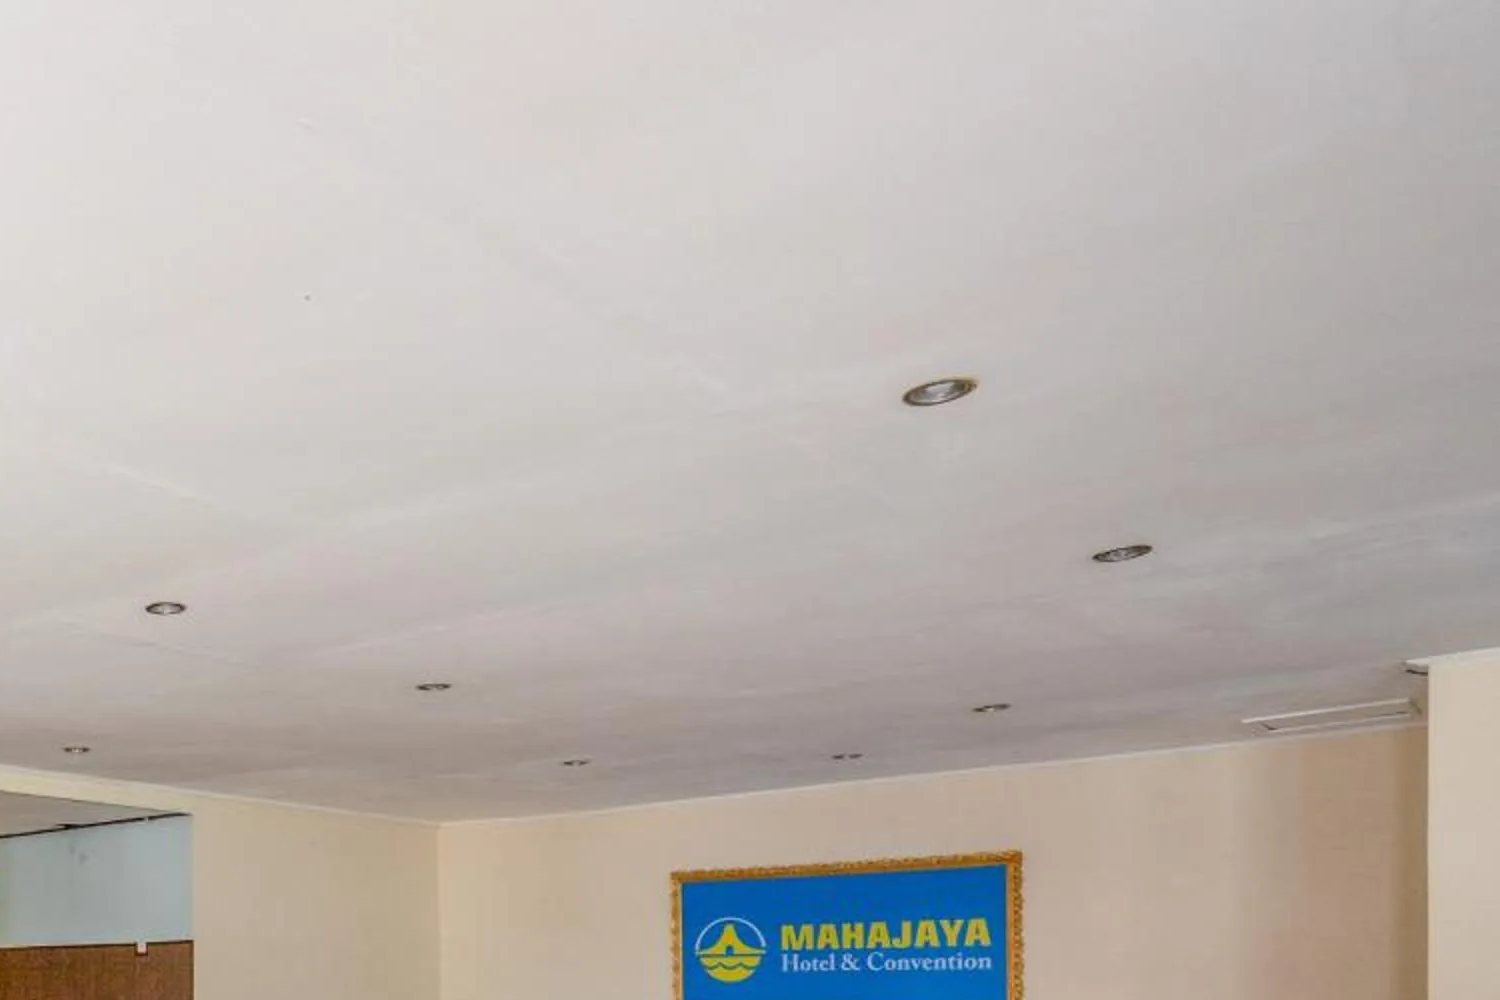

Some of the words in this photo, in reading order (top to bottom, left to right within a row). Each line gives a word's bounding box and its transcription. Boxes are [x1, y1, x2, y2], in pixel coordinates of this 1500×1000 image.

[781, 918, 991, 951] MAHAJAYA
[781, 952, 835, 973] Hotel
[841, 952, 860, 971] &
[866, 951, 992, 972] Convention
